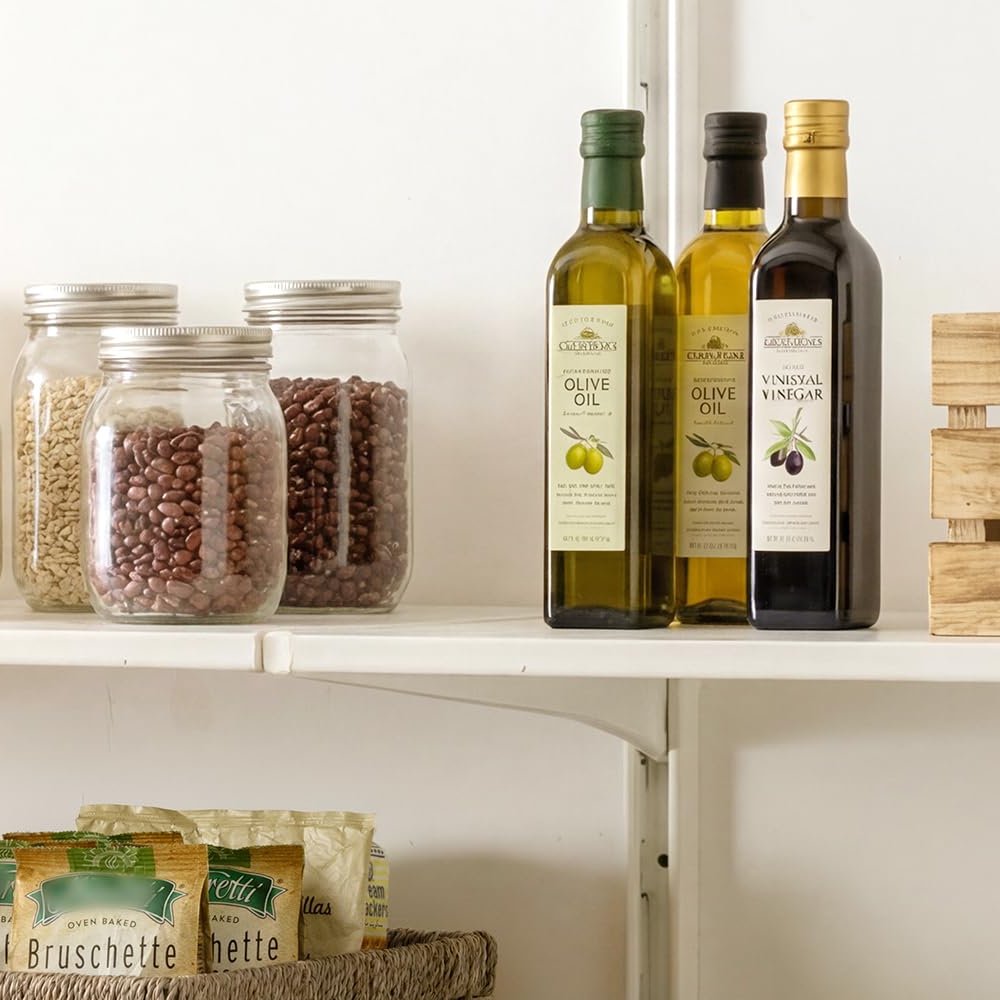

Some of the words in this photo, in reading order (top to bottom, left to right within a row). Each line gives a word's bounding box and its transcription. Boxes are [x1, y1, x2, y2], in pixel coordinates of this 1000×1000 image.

[564, 377, 610, 391] OLIVE
[574, 392, 600, 406] OIL
[691, 386, 736, 400] OLIVE
[762, 388, 824, 401] VINEGAR
[700, 401, 726, 415] OIL
[67, 918, 97, 930] OVEN
[102, 917, 137, 928] BAKED
[28, 936, 176, 969] Bruschette
[211, 930, 279, 963] hette
